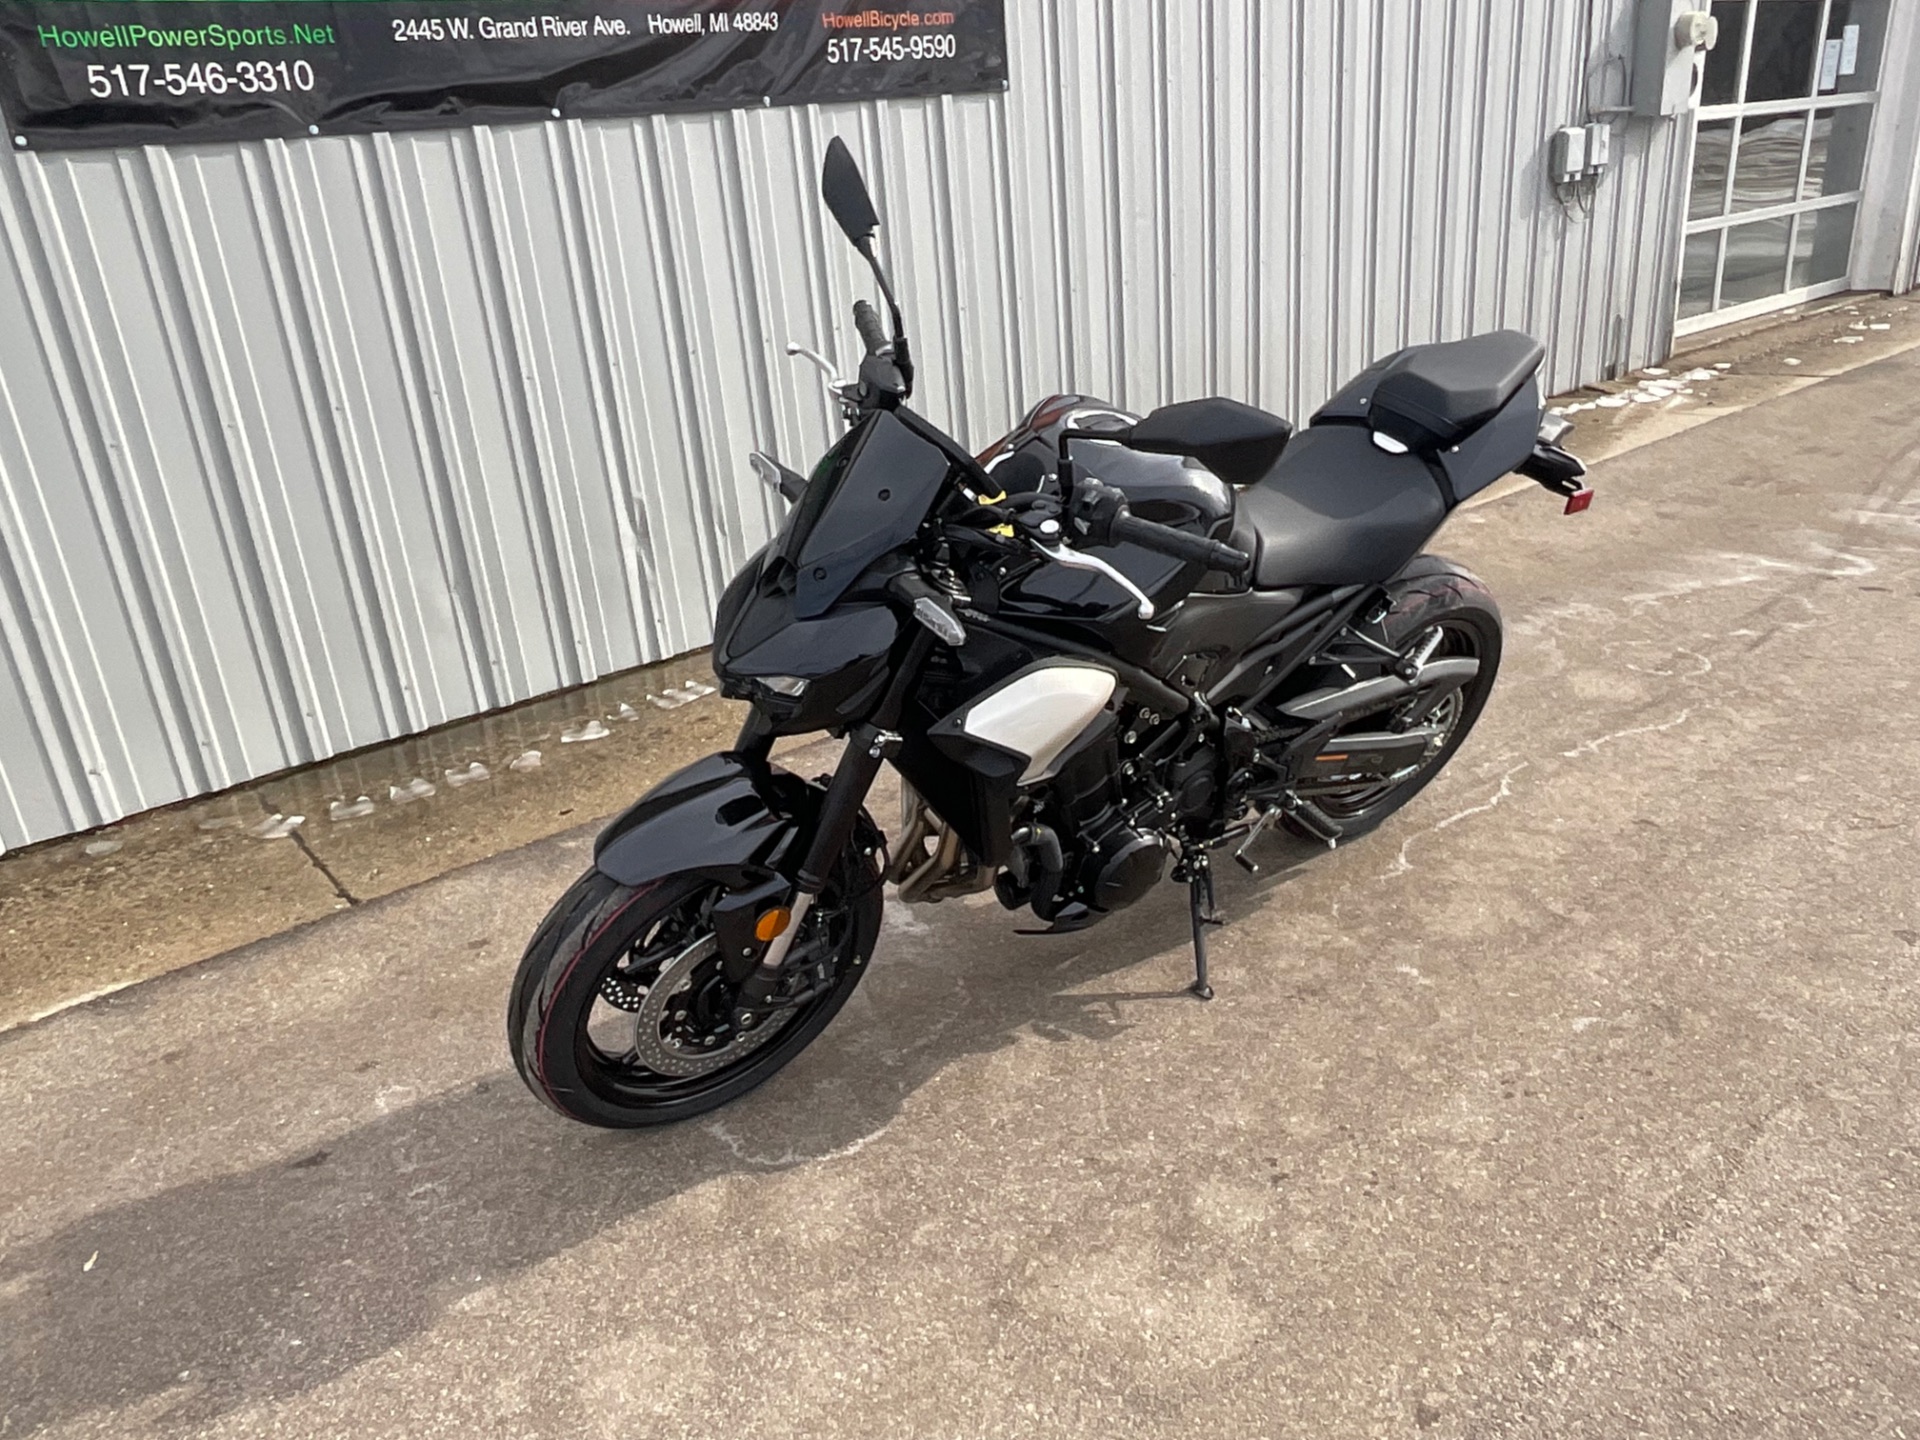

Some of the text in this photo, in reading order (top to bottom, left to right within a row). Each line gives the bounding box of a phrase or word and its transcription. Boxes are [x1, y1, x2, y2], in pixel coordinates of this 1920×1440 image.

[392, 12, 779, 41] 2445 W. Grand River Ave. Howell, MI 48843
[822, 10, 954, 30] HowellBicycle.com
[37, 24, 335, 50] HowellPowerSports.Net
[827, 34, 957, 64] 517-545-9590
[87, 60, 315, 98] 517-546-3310
